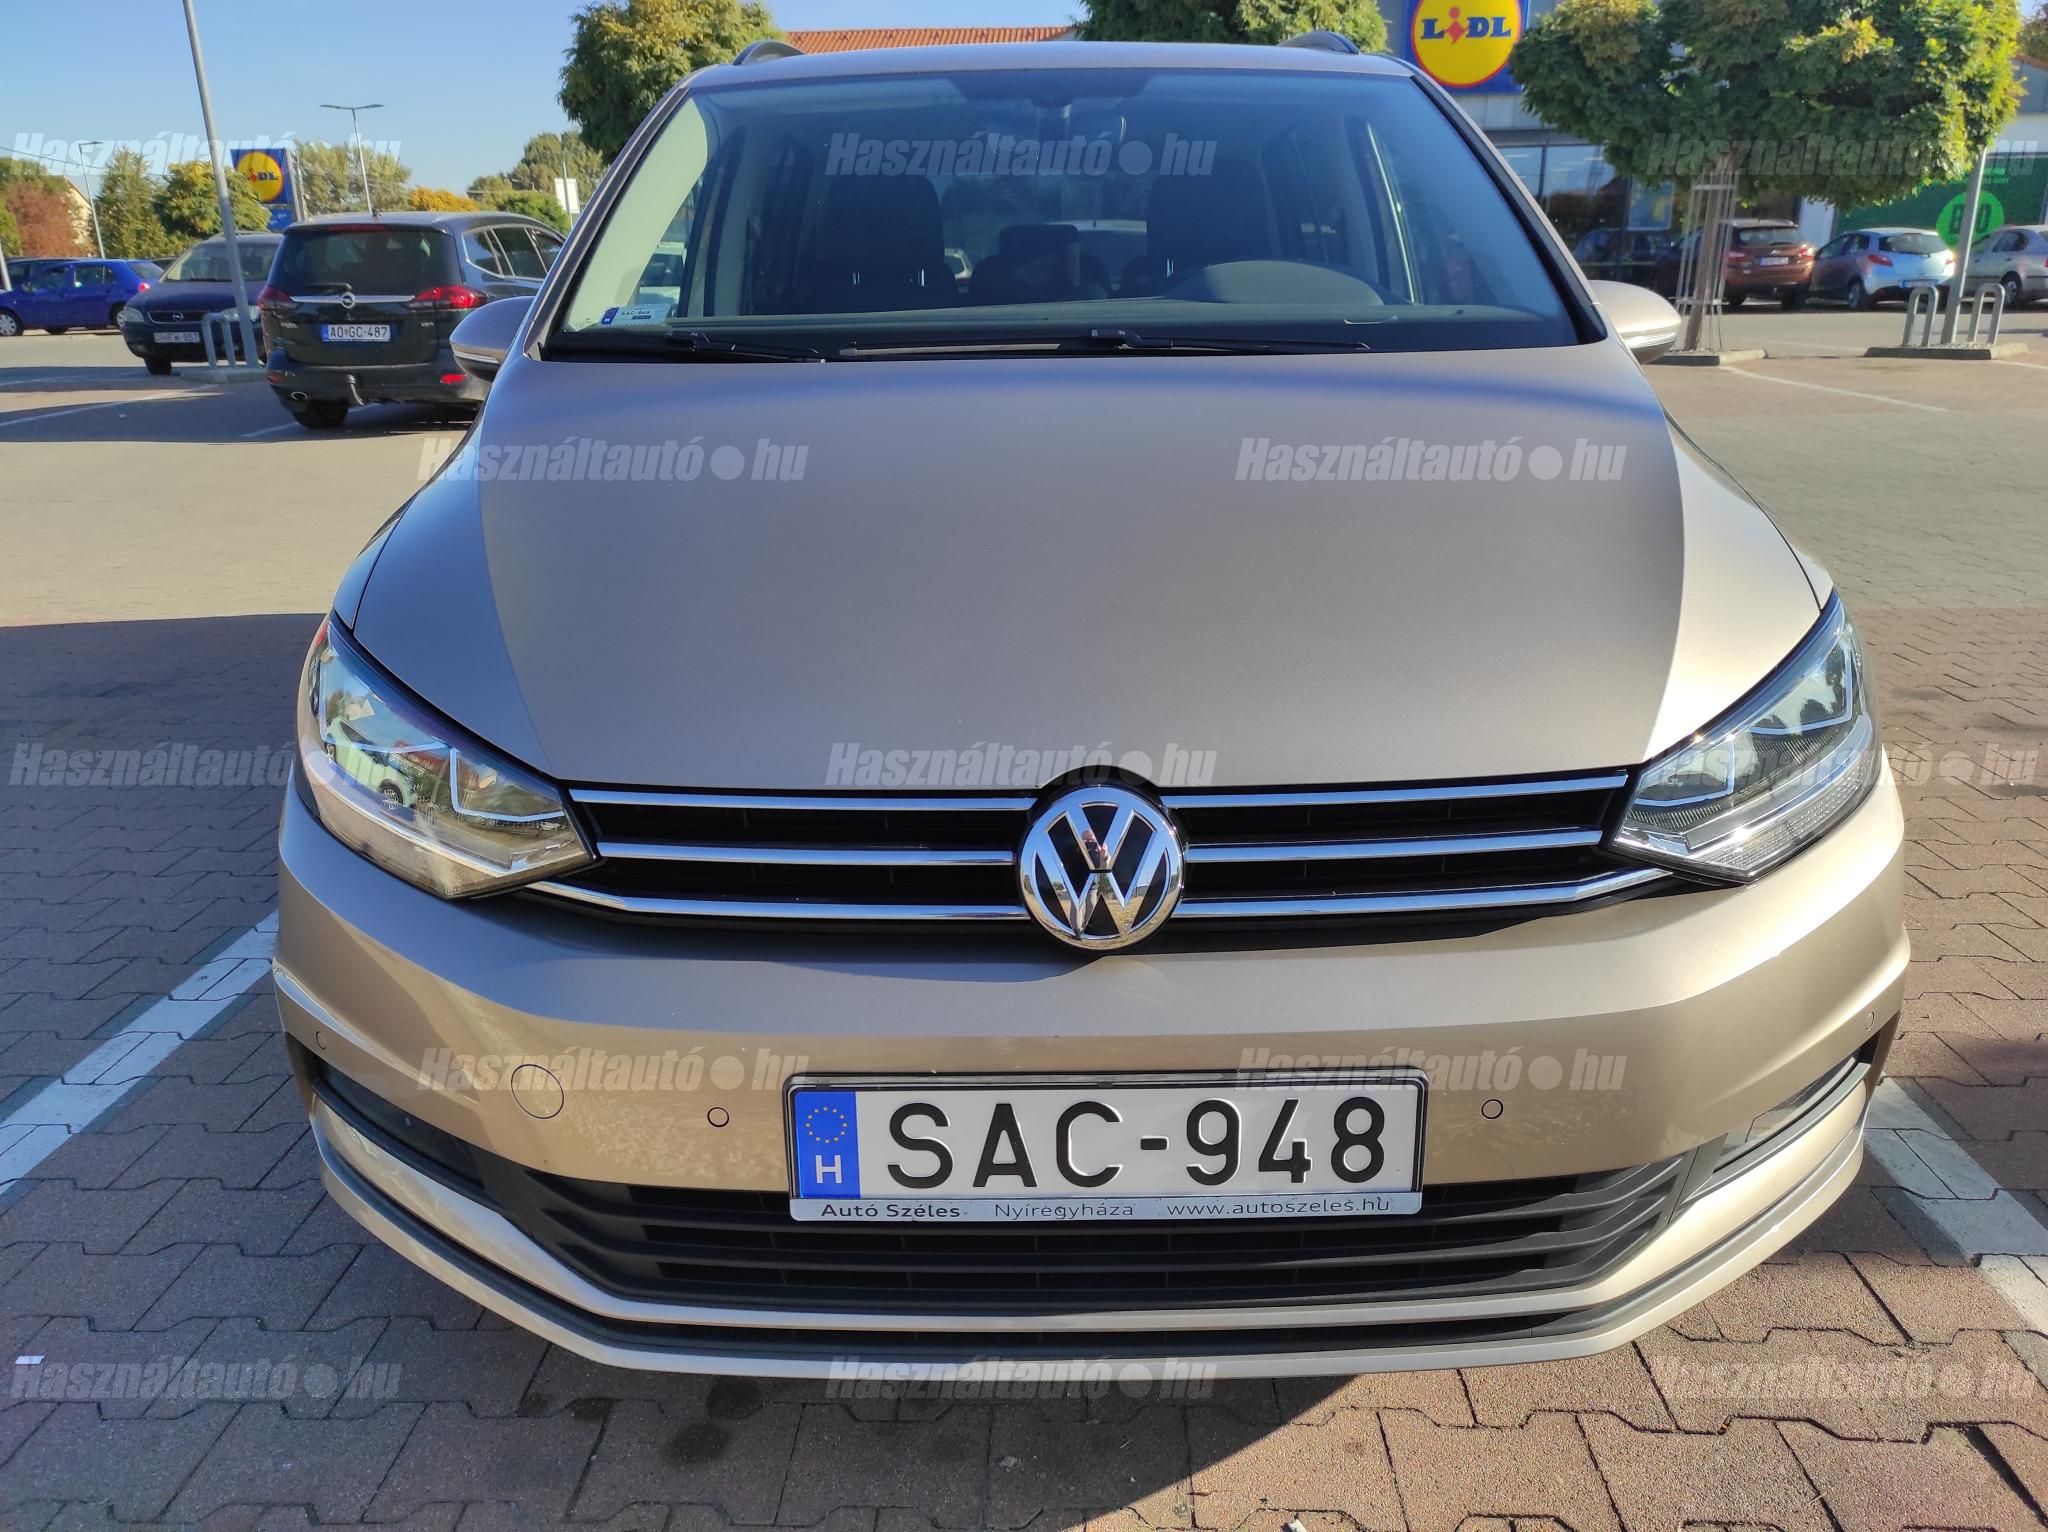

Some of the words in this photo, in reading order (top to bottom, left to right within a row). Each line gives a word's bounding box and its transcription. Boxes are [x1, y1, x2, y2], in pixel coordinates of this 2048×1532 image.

[887, 1096, 1386, 1189] SAC-948
[815, 1154, 843, 1184] H
[821, 1203, 878, 1217] Autó
[886, 1202, 961, 1218] Széles
[994, 1201, 1134, 1220] Nyíregyháza
[1167, 1197, 1391, 1216] www.autoszeles.hu
